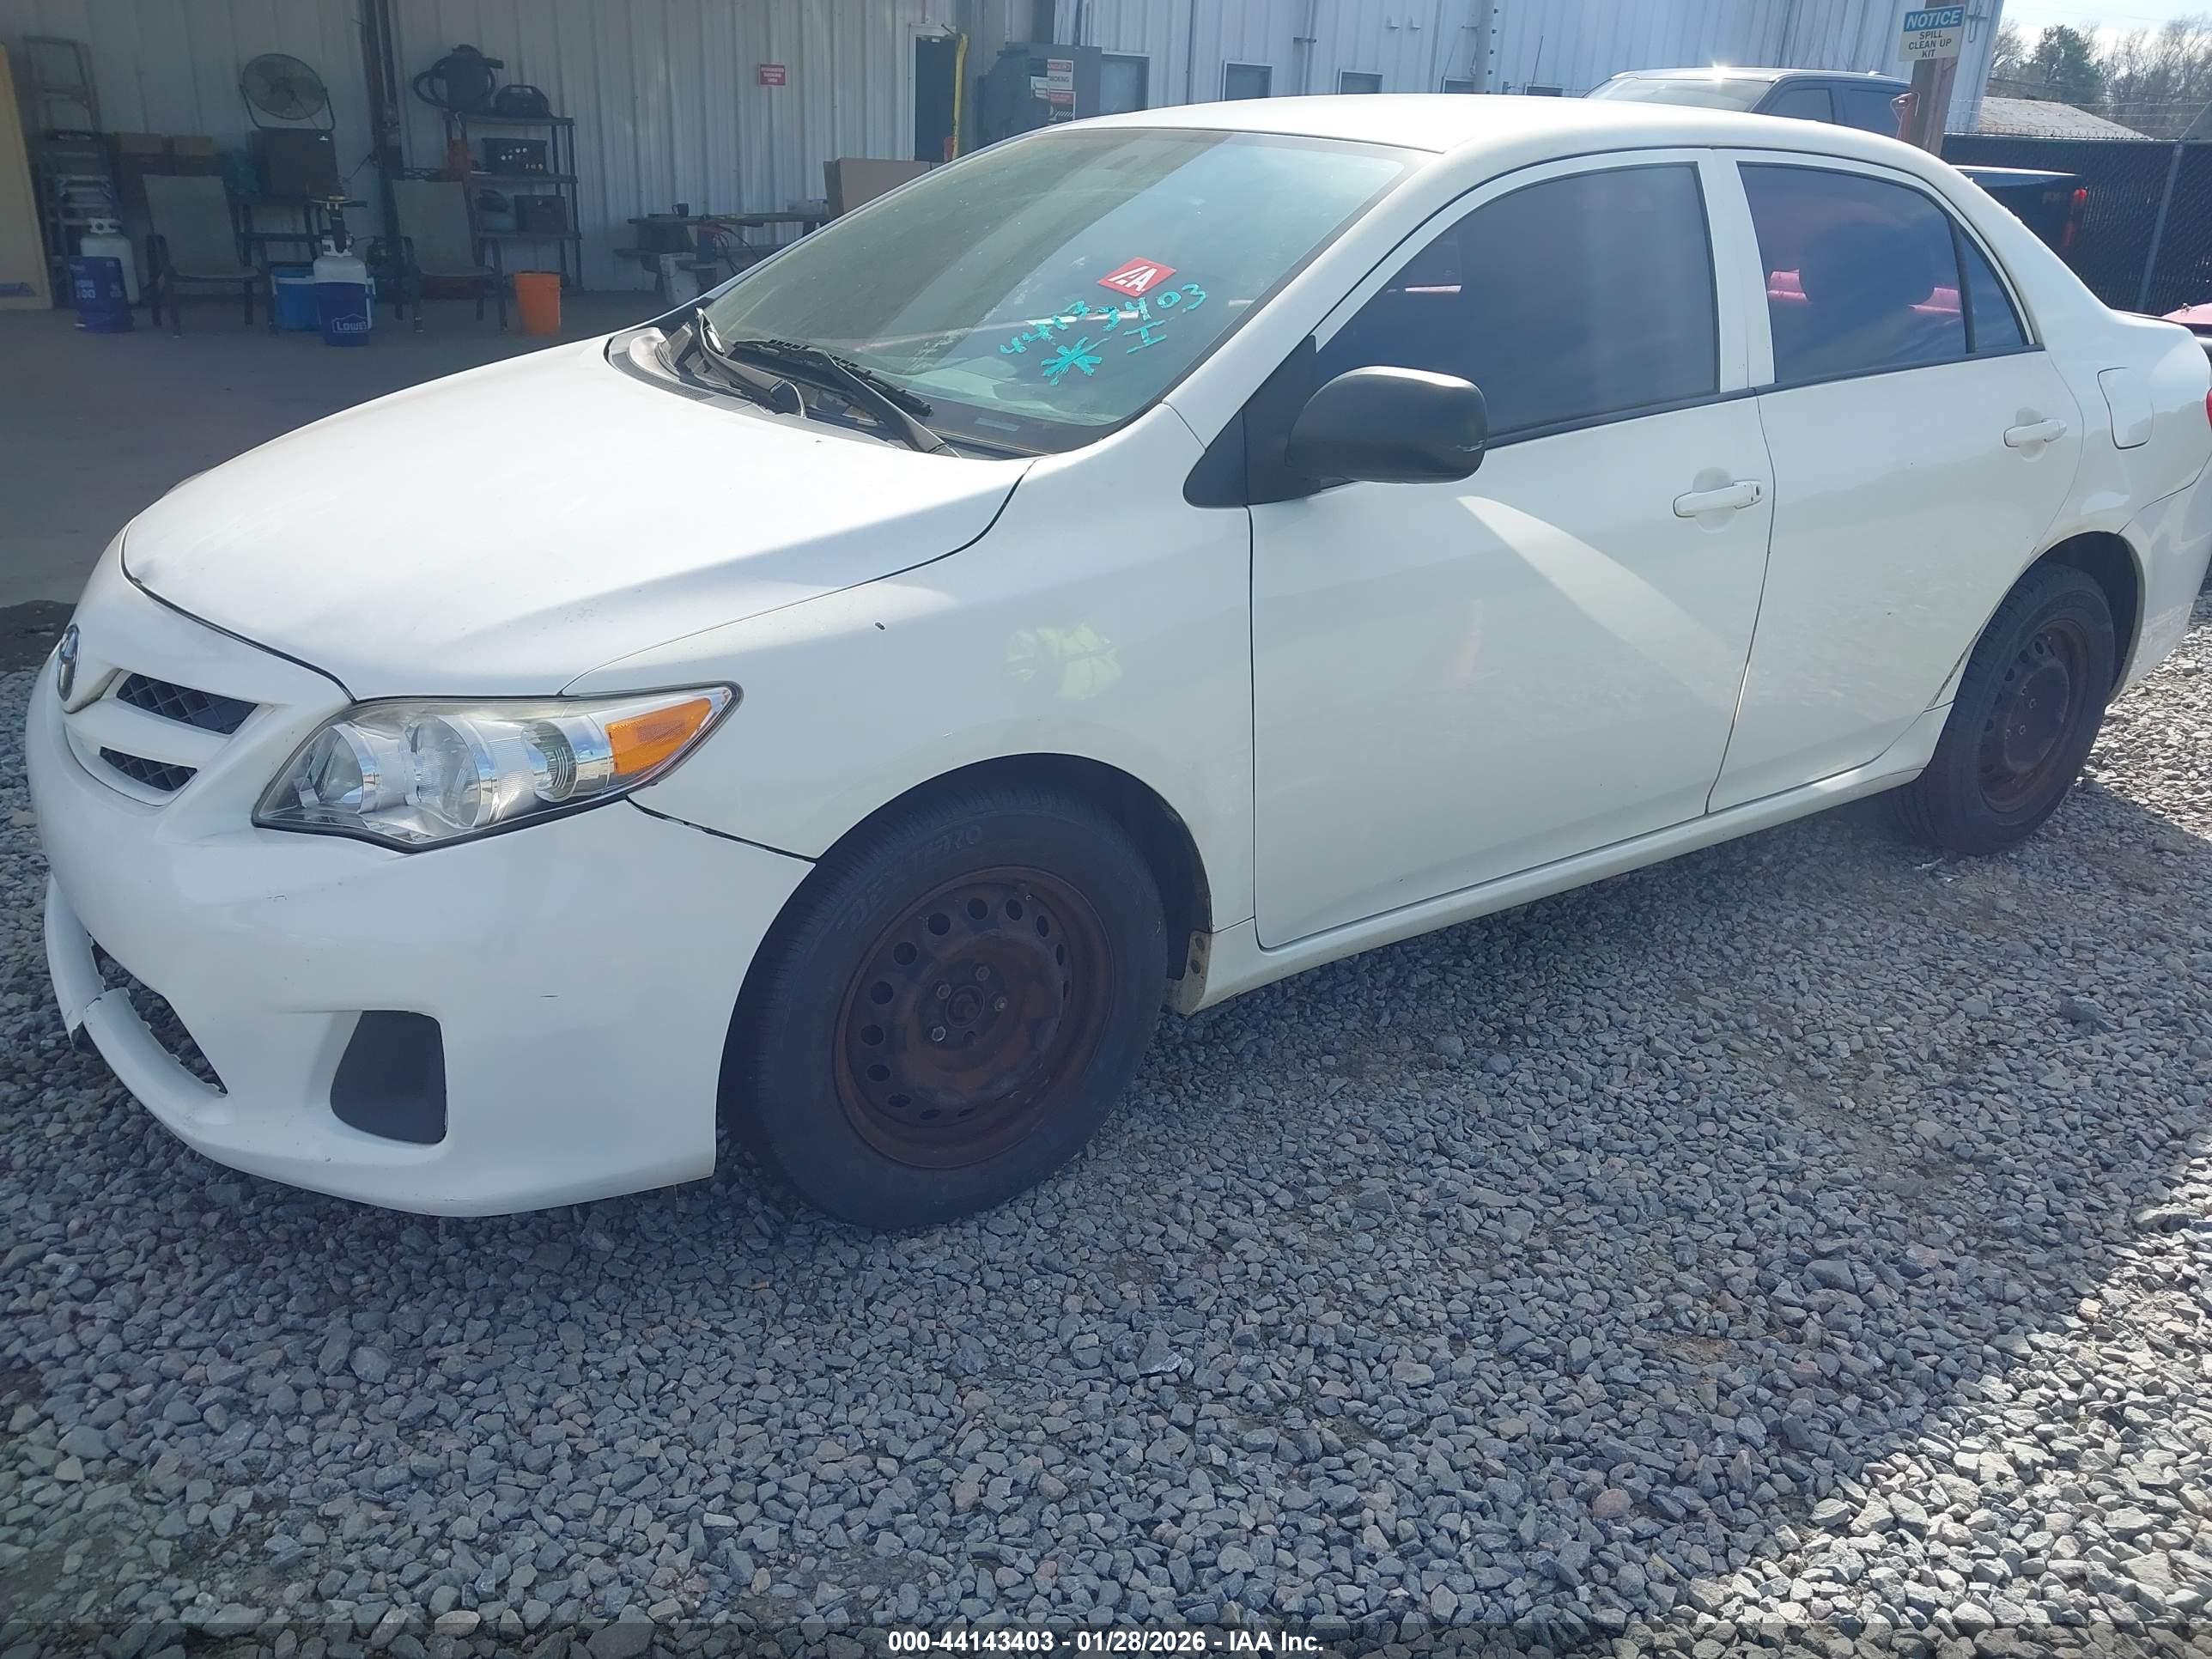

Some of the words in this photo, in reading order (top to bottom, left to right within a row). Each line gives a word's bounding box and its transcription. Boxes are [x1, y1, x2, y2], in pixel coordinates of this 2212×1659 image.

[1906, 10, 1962, 29] NOTICE
[1919, 30, 1943, 40] SPILL
[1908, 40, 1936, 50] CLEAN
[1939, 38, 1952, 47] UP
[1921, 49, 1936, 58] KIT
